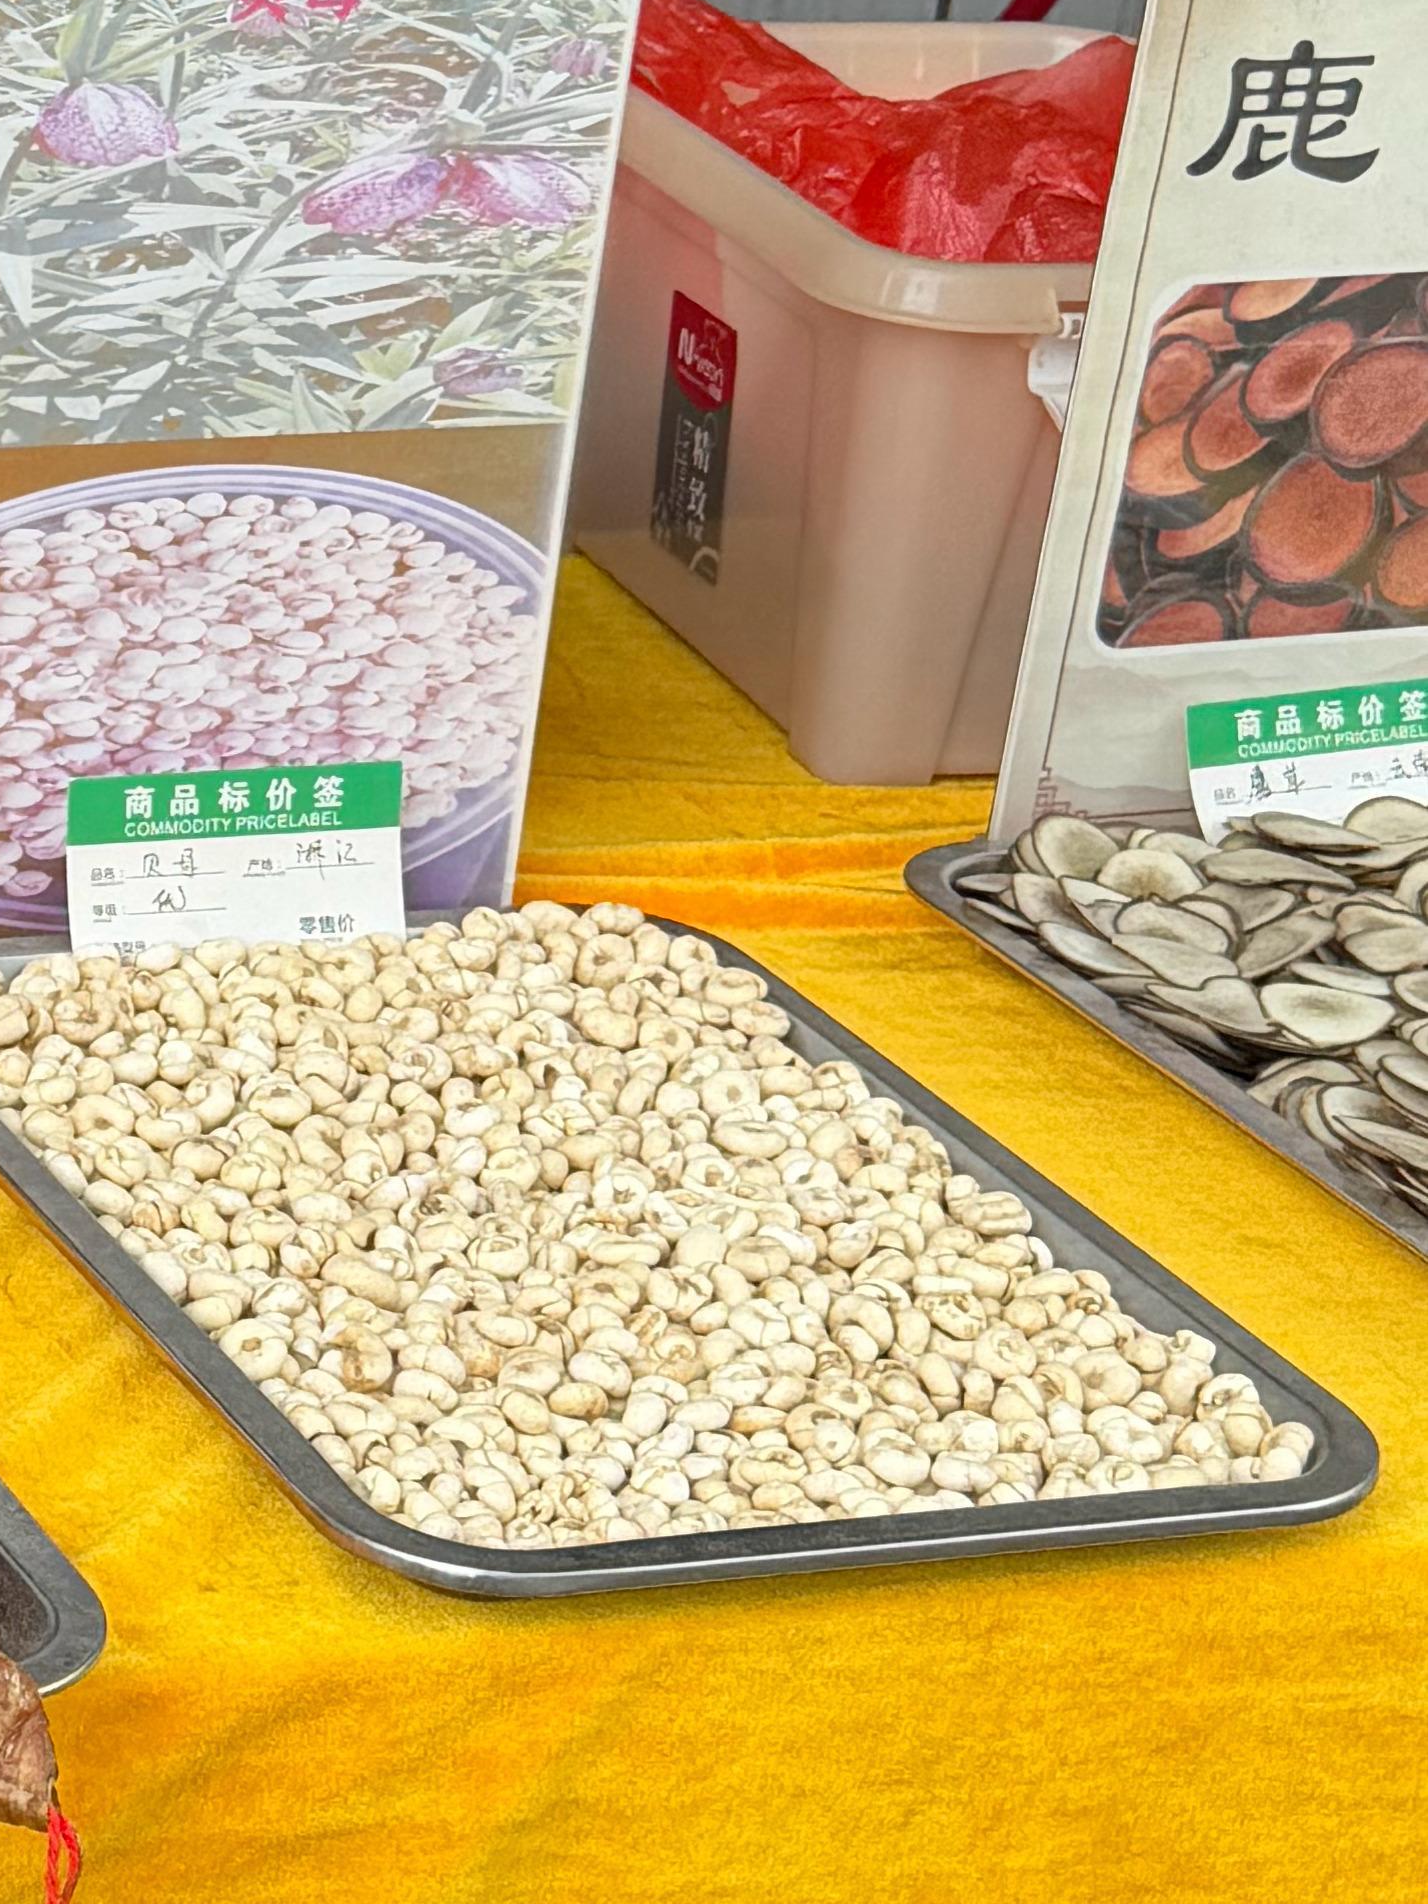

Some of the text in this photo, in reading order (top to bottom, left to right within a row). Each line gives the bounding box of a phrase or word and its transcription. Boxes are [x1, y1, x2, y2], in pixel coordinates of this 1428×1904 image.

[1187, 41, 1378, 182] 鹿
[1234, 690, 1428, 741] 商品标价签
[1238, 735, 1330, 758] COMMODITY
[124, 776, 345, 819] 商品标价签
[125, 811, 342, 837] COMMODITY PRICELABEL
[299, 913, 355, 934] 零售价
